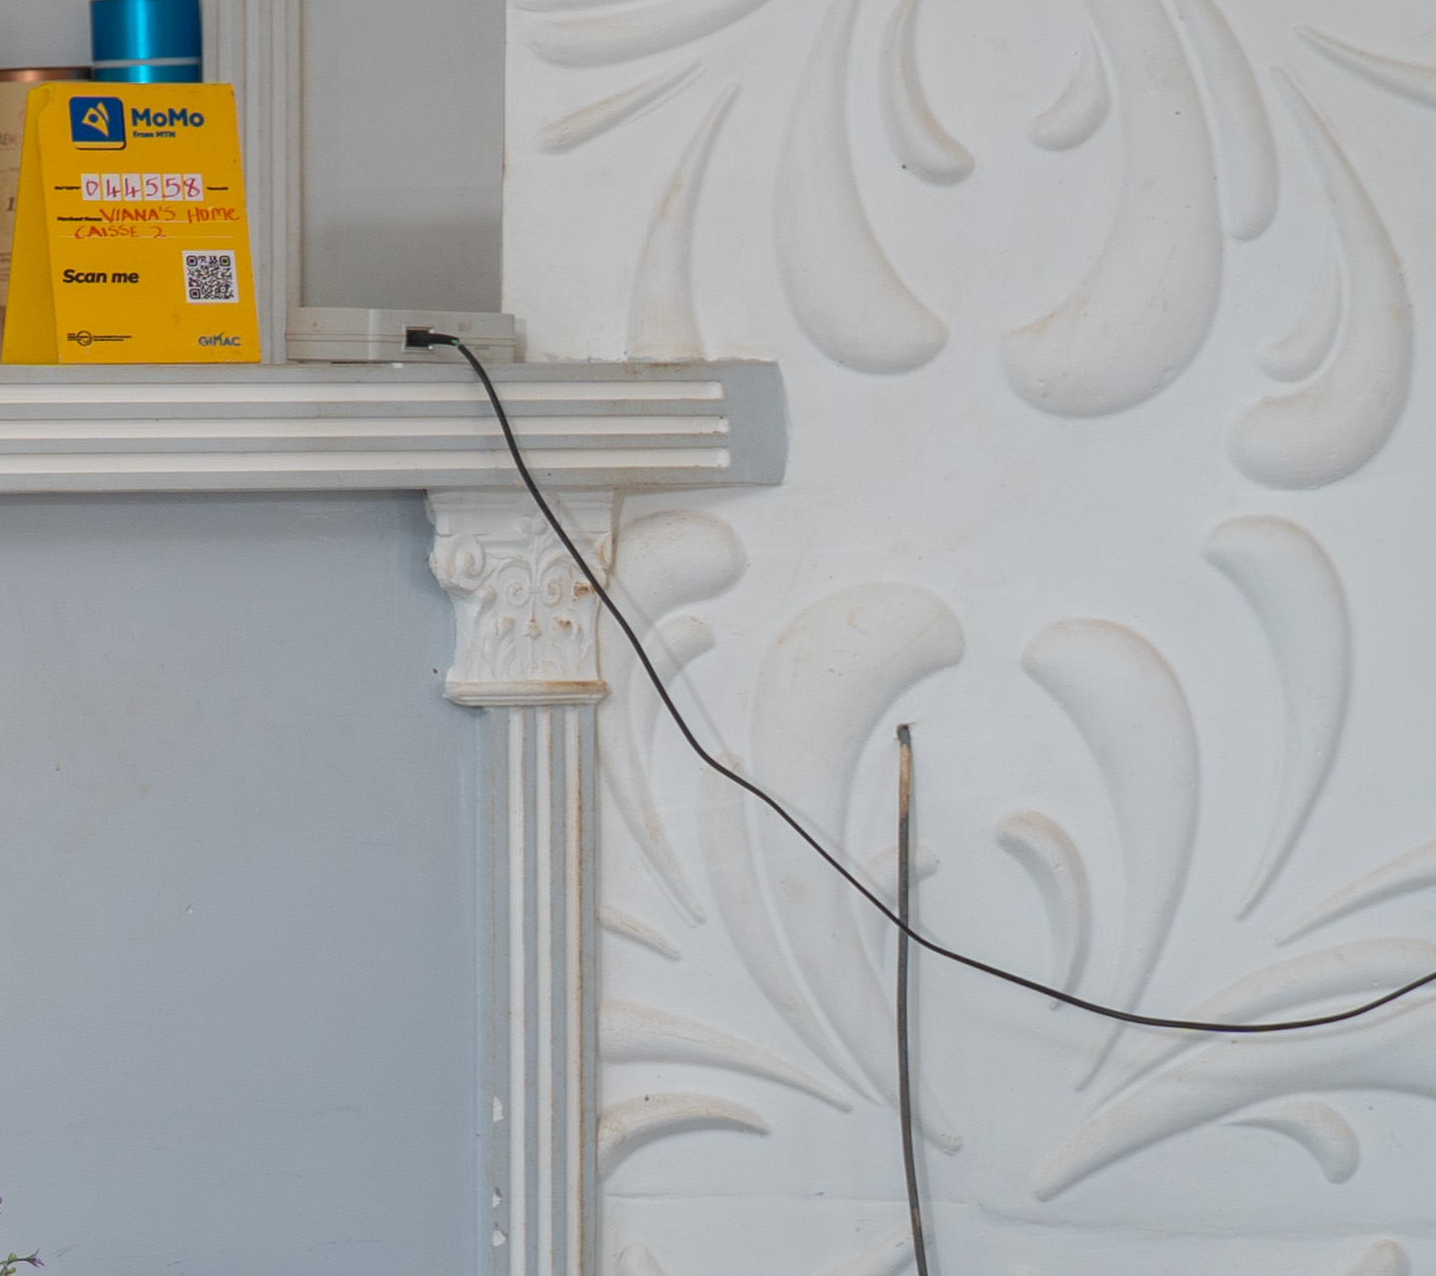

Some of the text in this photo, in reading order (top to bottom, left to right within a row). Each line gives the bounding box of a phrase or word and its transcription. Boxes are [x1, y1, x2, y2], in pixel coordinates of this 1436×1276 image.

[131, 107, 205, 128] MoMo
[132, 130, 176, 139] from MTN
[84, 176, 202, 199] 044558
[99, 206, 176, 223] VIANA'S
[74, 225, 167, 240] CAISSE 2
[62, 268, 140, 284] Scan me
